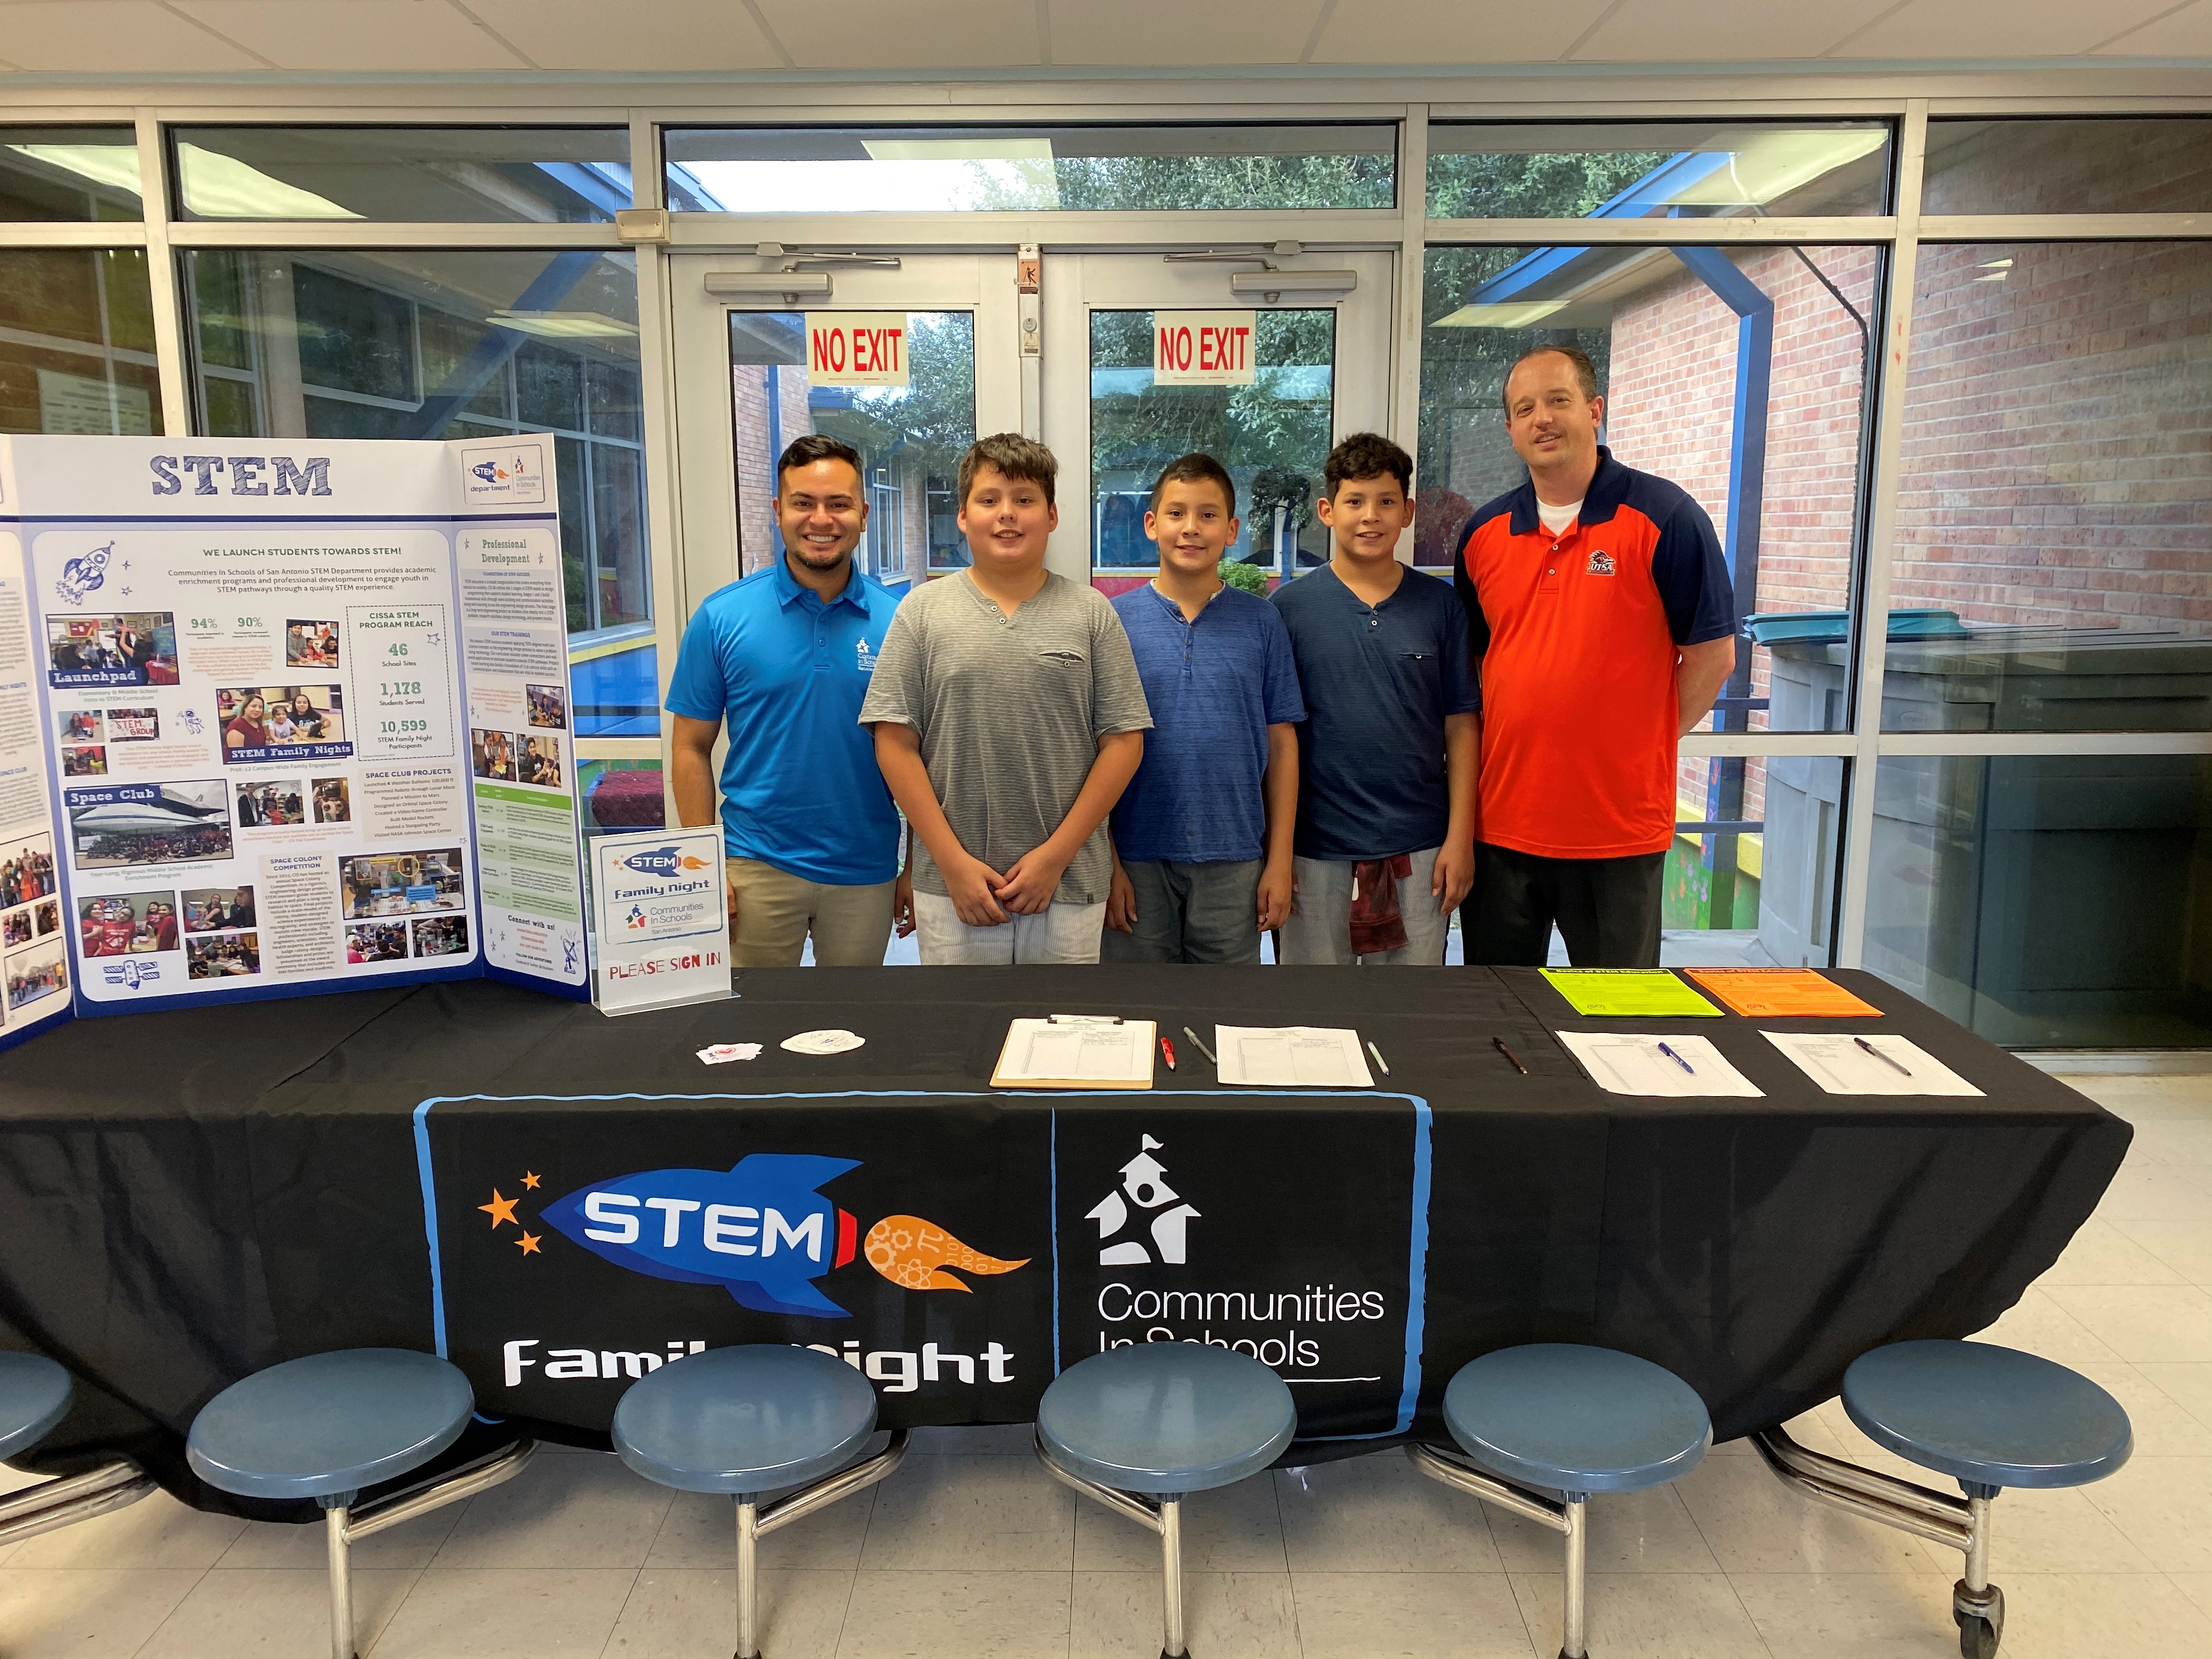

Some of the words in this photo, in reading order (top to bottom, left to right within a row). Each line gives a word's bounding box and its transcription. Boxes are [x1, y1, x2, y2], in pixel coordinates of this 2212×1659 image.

[813, 328, 845, 373] NO
[853, 328, 902, 371] EXIT
[1160, 326, 1192, 371] NO
[1200, 327, 1249, 370] EXIT
[150, 455, 332, 496] STEM
[475, 467, 494, 476] STEM
[471, 484, 510, 493] department
[482, 539, 526, 549] Professional
[482, 554, 529, 565] Development
[1590, 563, 1613, 571] UTSA
[273, 577, 317, 585] professional
[191, 618, 217, 628] 94%
[238, 617, 262, 627] 90%
[388, 644, 408, 656] 46
[53, 670, 137, 684] Launchpad
[381, 682, 421, 698] 1,178
[381, 720, 427, 734] 10,599
[232, 749, 266, 758] STEM
[270, 747, 310, 757] Family
[314, 745, 351, 755] Nights
[70, 793, 113, 805] Space
[120, 789, 154, 800] Club
[631, 857, 676, 867] STEM
[615, 886, 664, 899] Family
[669, 880, 710, 893] Night
[650, 902, 703, 915] Communities
[508, 915, 530, 925] Connect
[659, 912, 692, 923] Schools
[610, 960, 665, 980] PLEASE
[670, 954, 700, 971] SIGN
[707, 951, 720, 966] IN
[584, 1192, 824, 1262] STEM
[1098, 1283, 1385, 1322] Communities
[1147, 1327, 1319, 1367] ools
[503, 1339, 706, 1387] Fami
[791, 1340, 1015, 1392] ight
